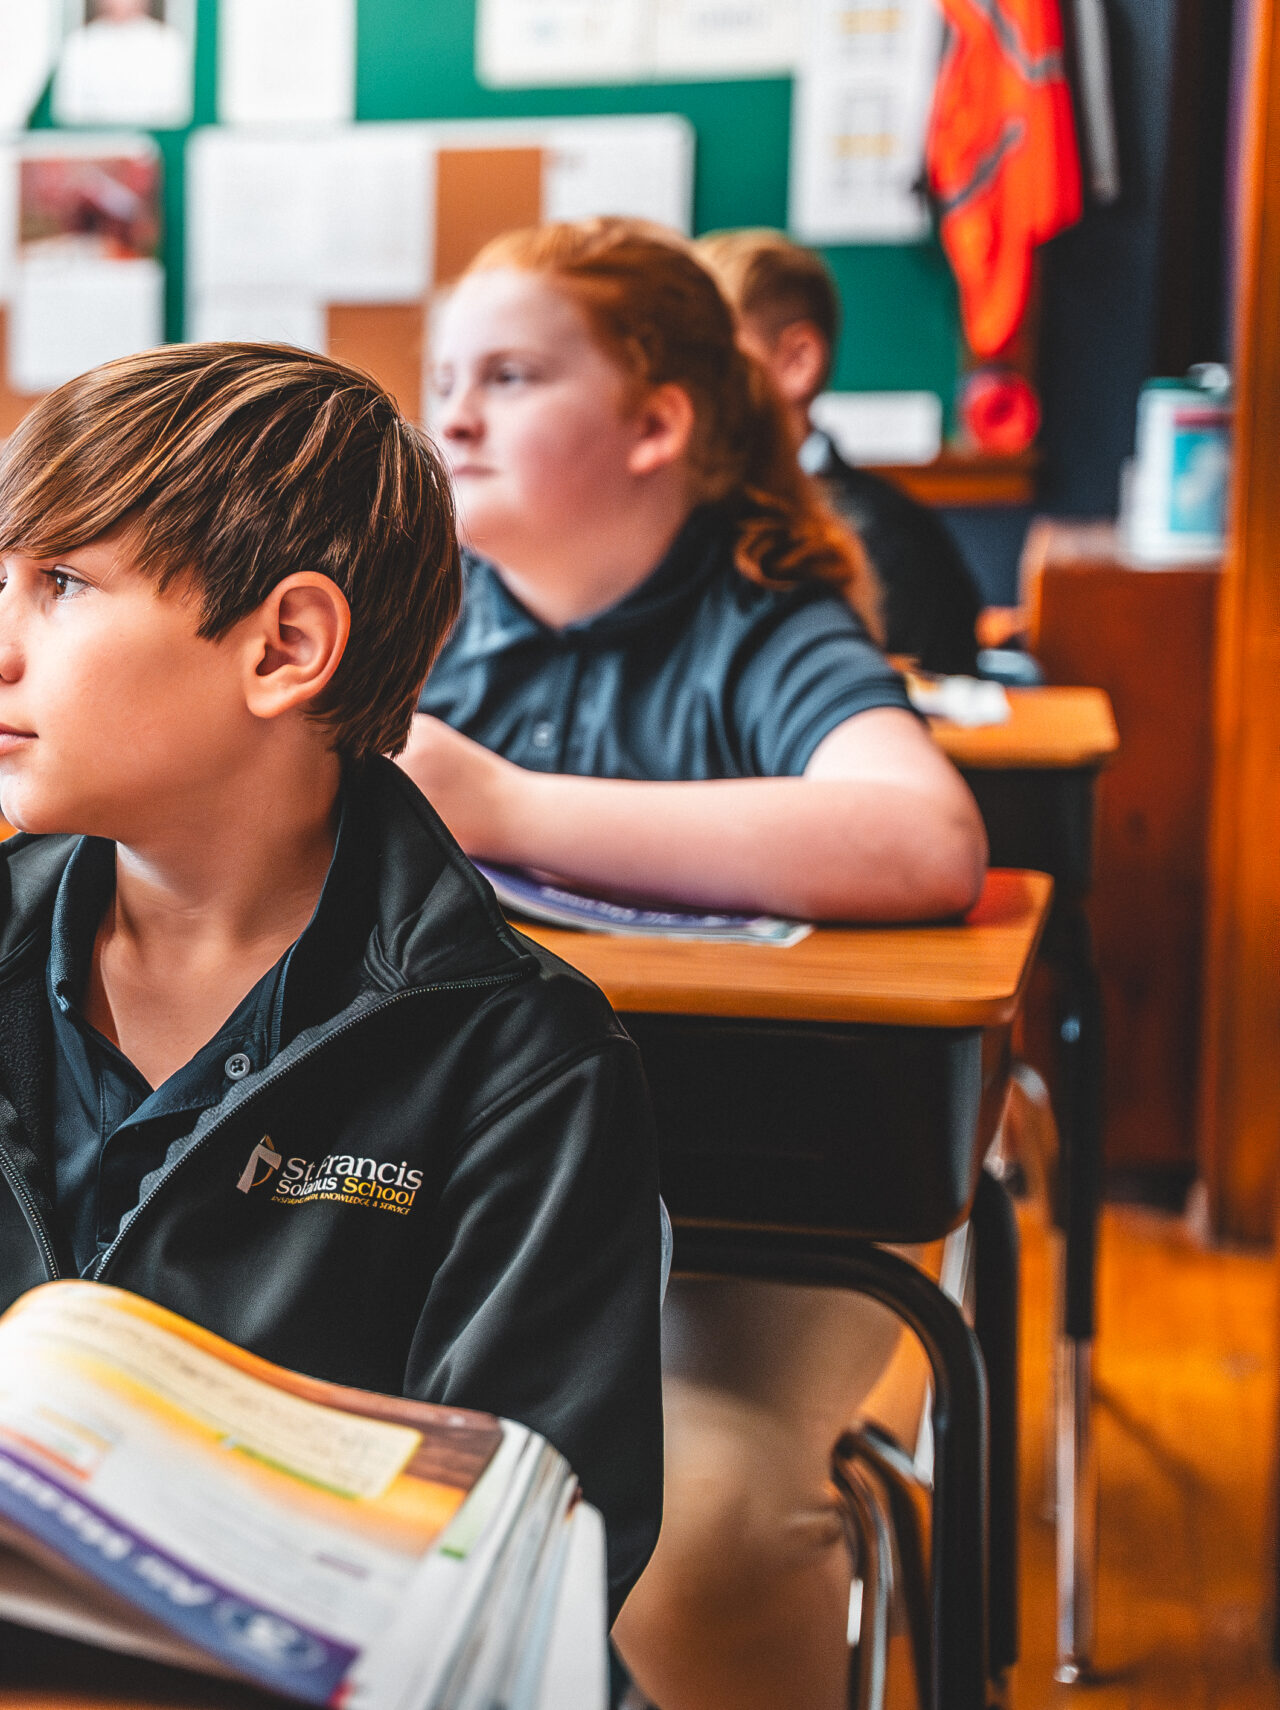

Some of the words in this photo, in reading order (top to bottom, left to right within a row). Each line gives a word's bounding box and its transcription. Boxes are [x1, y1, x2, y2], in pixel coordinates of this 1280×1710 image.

[282, 1157, 315, 1181] St.
[315, 1154, 424, 1190] Francis
[276, 1177, 338, 1196] Solanus
[342, 1177, 416, 1206] School
